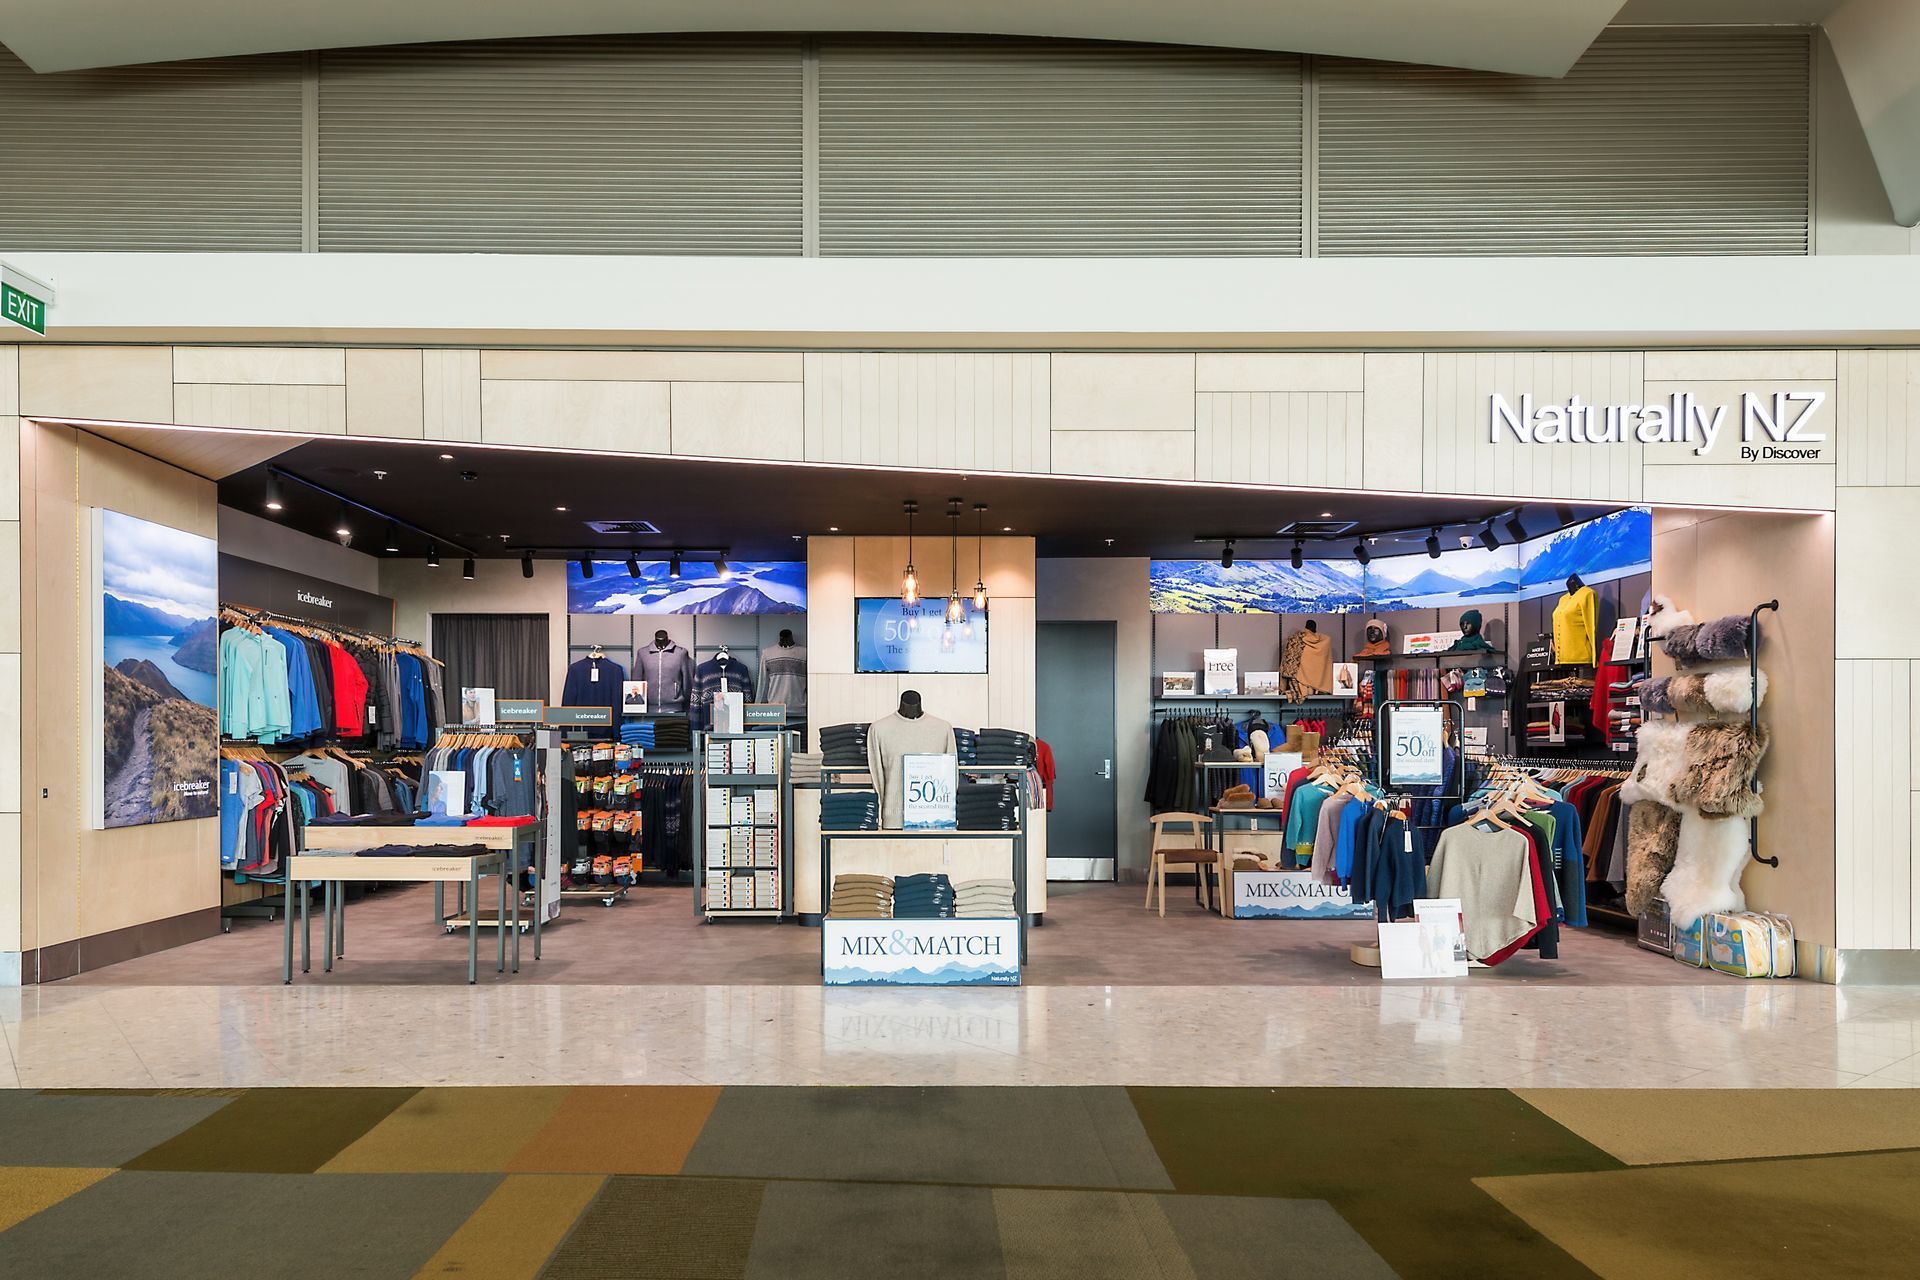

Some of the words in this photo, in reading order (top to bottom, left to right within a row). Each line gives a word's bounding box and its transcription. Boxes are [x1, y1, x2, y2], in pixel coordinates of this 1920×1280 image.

[8, 291, 39, 326] EXIT
[1490, 392, 1728, 456] Naturally
[1741, 391, 1826, 443] NZ
[1741, 446, 1758, 462] By
[1762, 446, 1821, 460] Discover
[297, 589, 333, 609] icebreaker
[902, 607, 919, 618] Buy
[929, 608, 942, 618] get
[886, 645, 903, 655] The
[1208, 662, 1234, 672] Free
[500, 707, 538, 715] icebreaker
[1396, 734, 1434, 757] 50%
[1421, 747, 1437, 757] off
[173, 779, 211, 791] icebreaker
[909, 779, 948, 803] 50%
[936, 792, 951, 803] off
[1245, 878, 1351, 898] MIX&MATC
[841, 929, 1002, 956] MIX&MATCH
